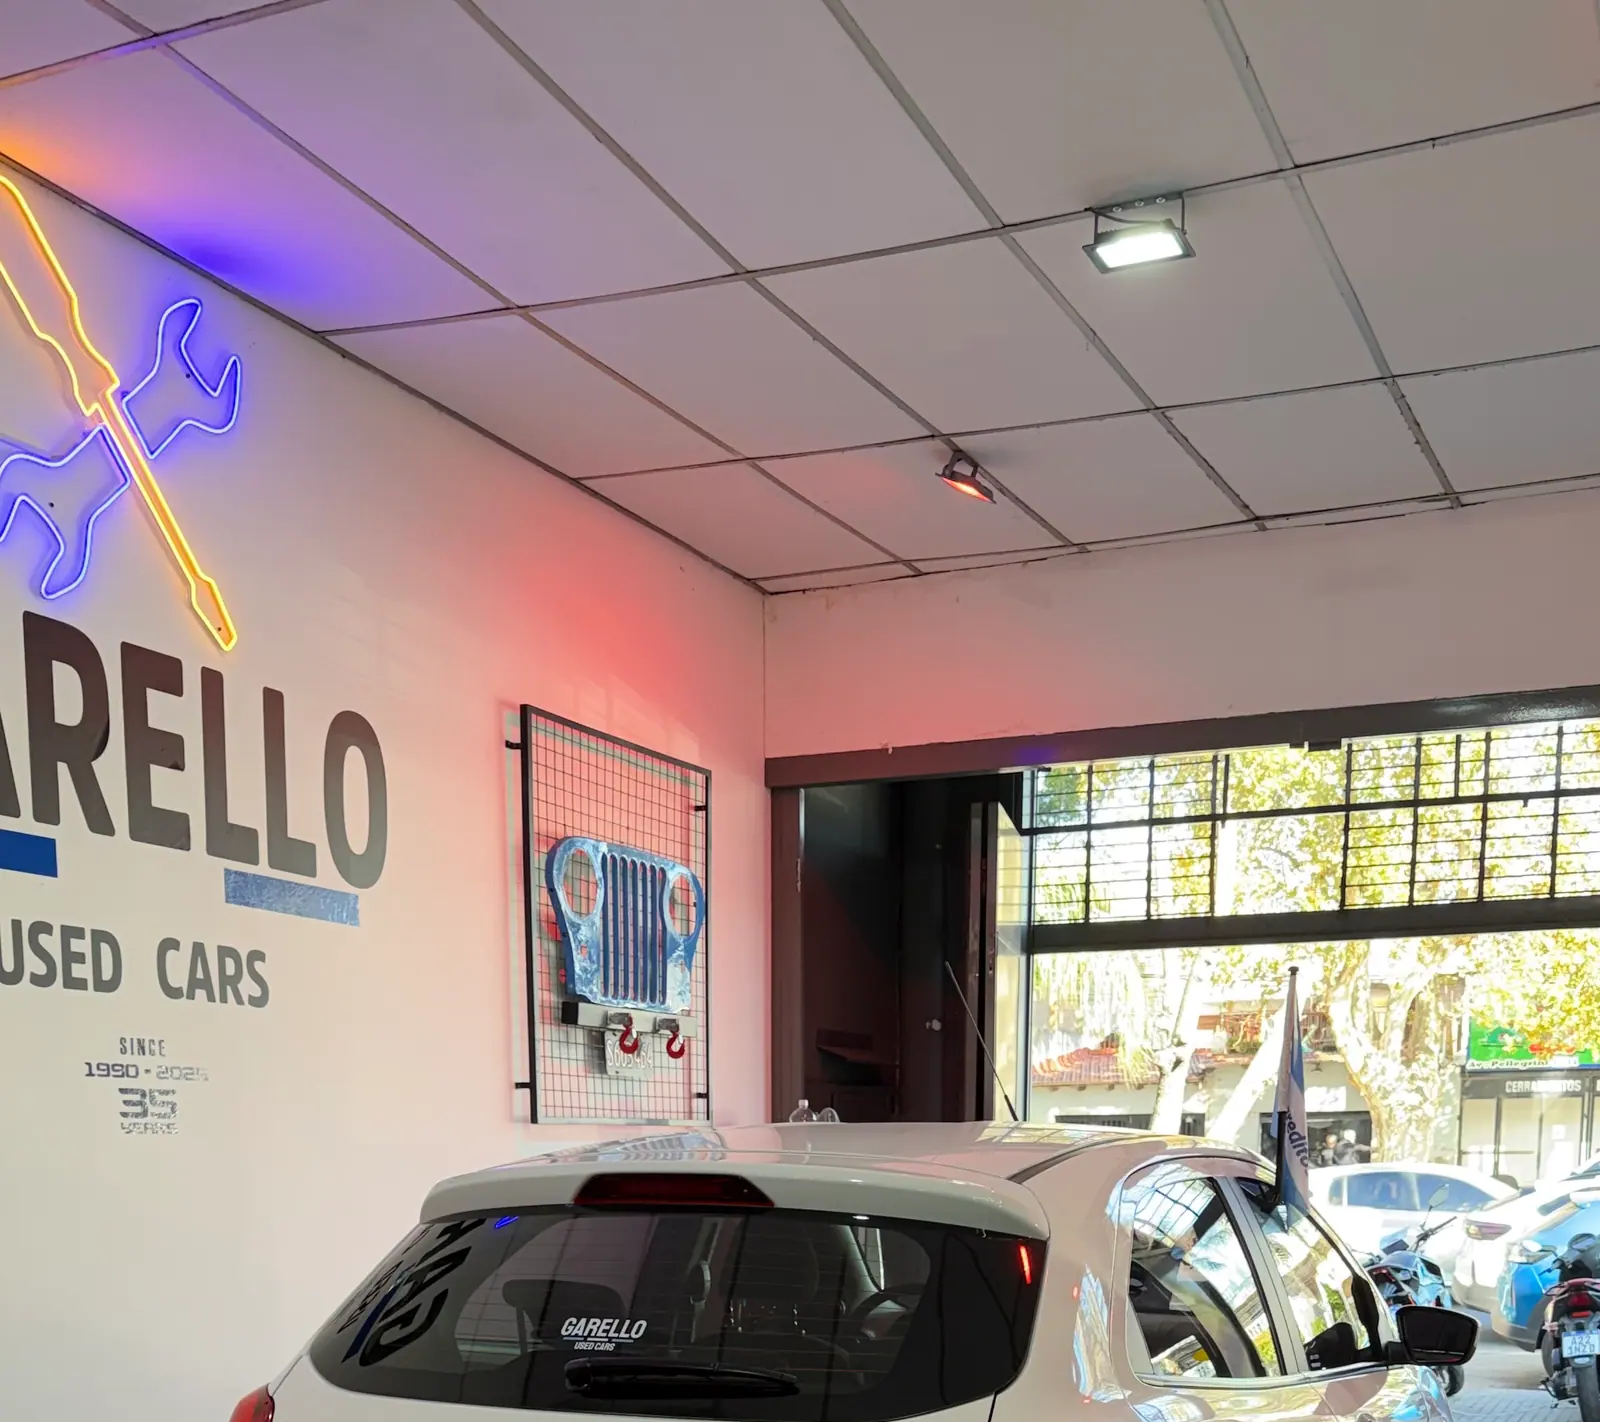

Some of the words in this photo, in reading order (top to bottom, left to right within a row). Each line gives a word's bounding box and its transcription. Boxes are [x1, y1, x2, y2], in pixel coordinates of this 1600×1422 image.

[0, 610, 388, 890] RELLO
[0, 919, 122, 993] USED
[157, 937, 269, 1008] CARS
[119, 1037, 166, 1057] SINCE
[84, 1062, 139, 1079] 1990
[118, 1088, 177, 1119] 35
[561, 1317, 648, 1339] GARELLO
[573, 1341, 595, 1351] USED
[594, 1343, 616, 1352] CARS
